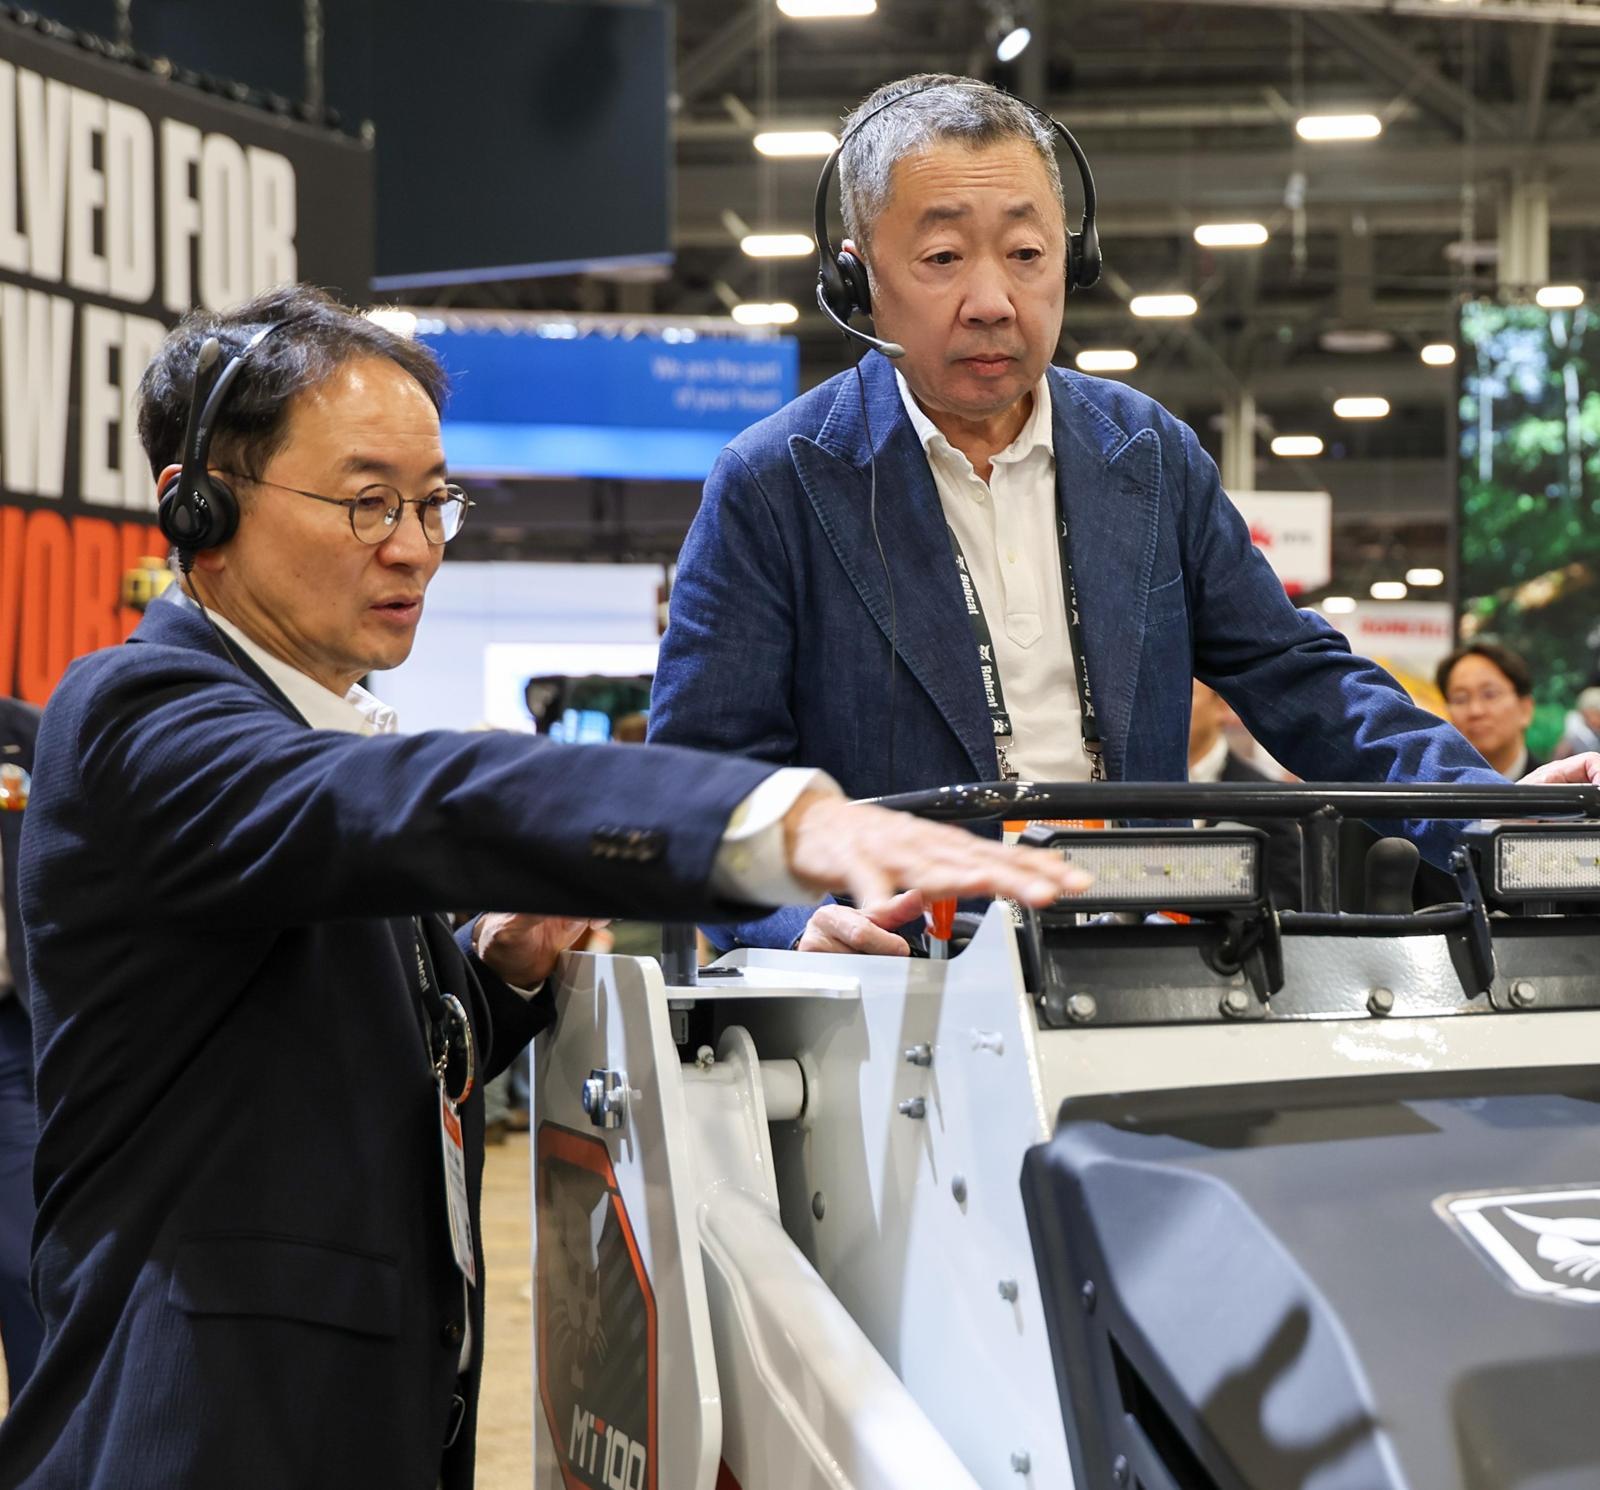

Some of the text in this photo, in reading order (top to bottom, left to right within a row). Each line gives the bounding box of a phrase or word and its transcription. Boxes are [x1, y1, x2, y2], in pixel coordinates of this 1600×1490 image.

[161, 116, 298, 315] FOR
[960, 573, 980, 615] Bobcat
[980, 665, 999, 708] Bobcat
